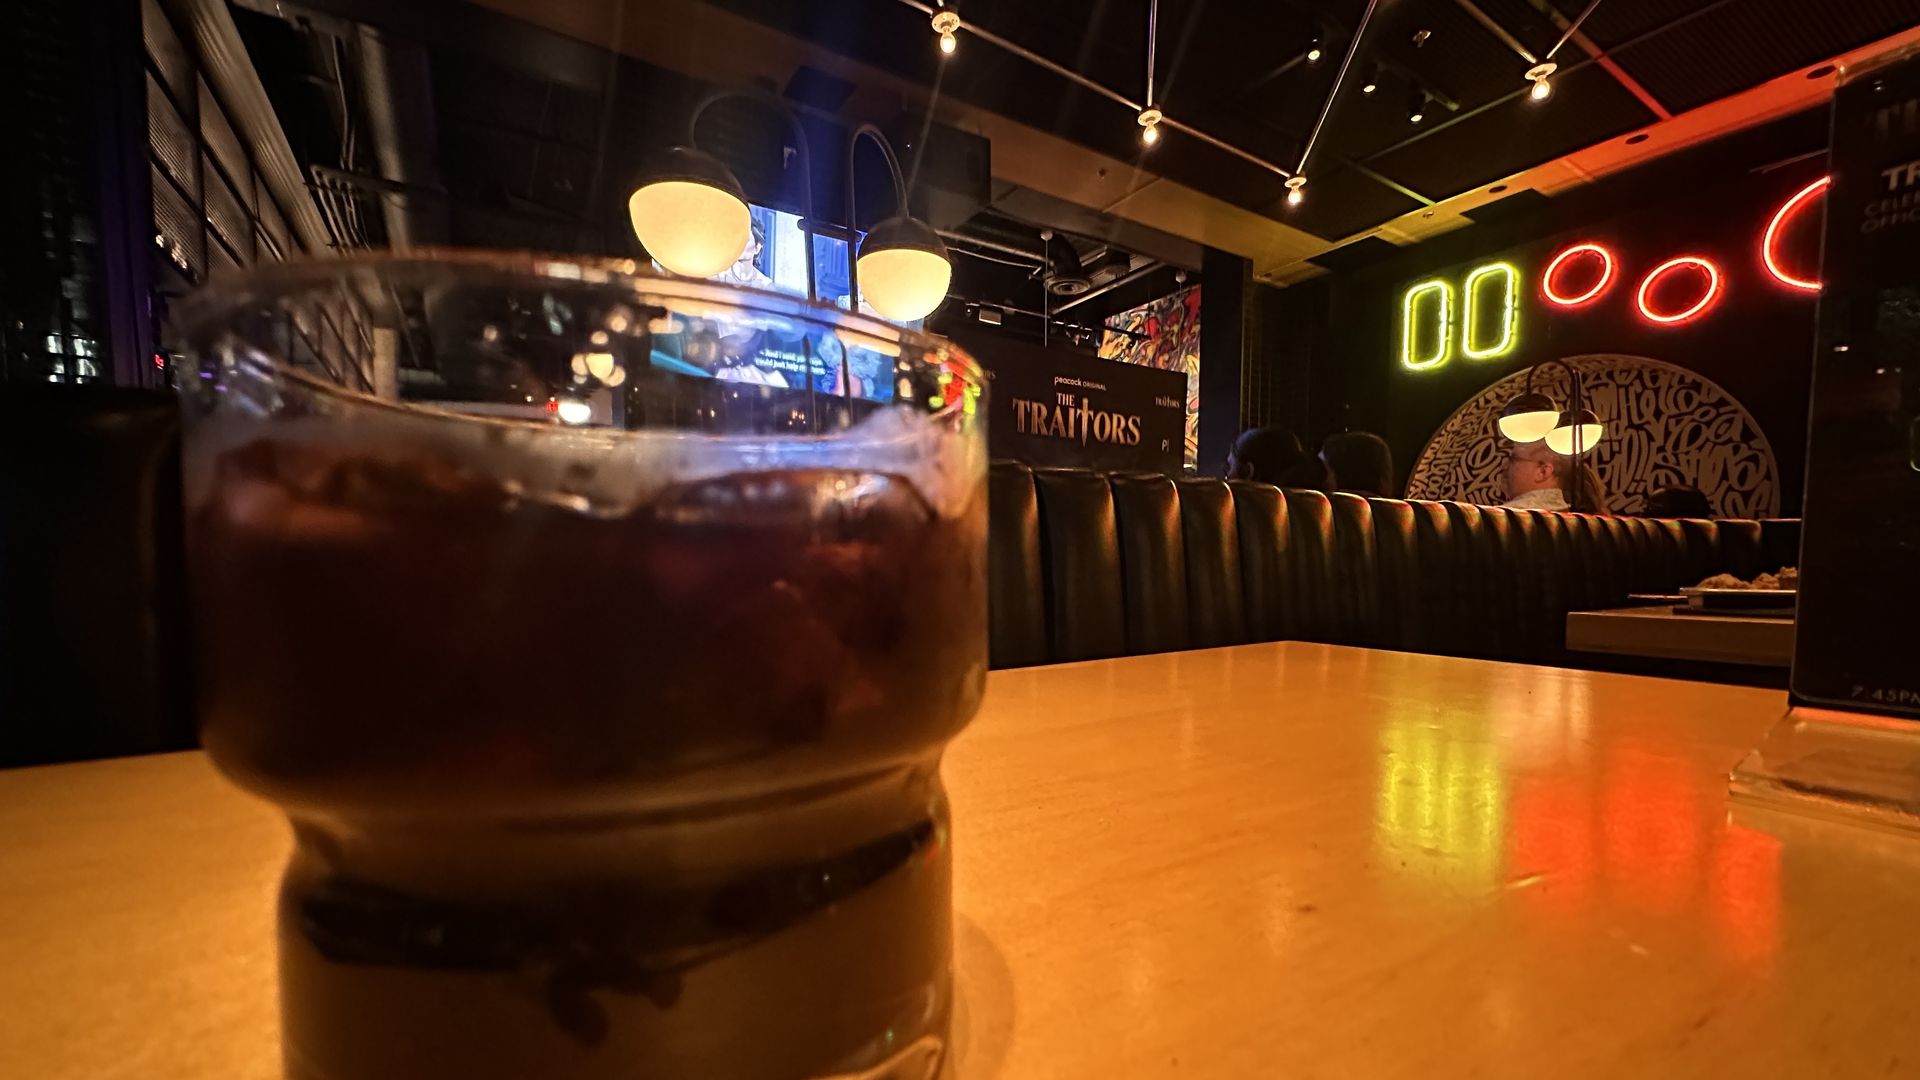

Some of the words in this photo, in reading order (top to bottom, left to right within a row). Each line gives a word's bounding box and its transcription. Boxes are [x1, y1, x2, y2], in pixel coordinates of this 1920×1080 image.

[1054, 376, 1081, 386] peacock
[1056, 392, 1075, 407] THE
[1012, 398, 1140, 447] TRAITORS
